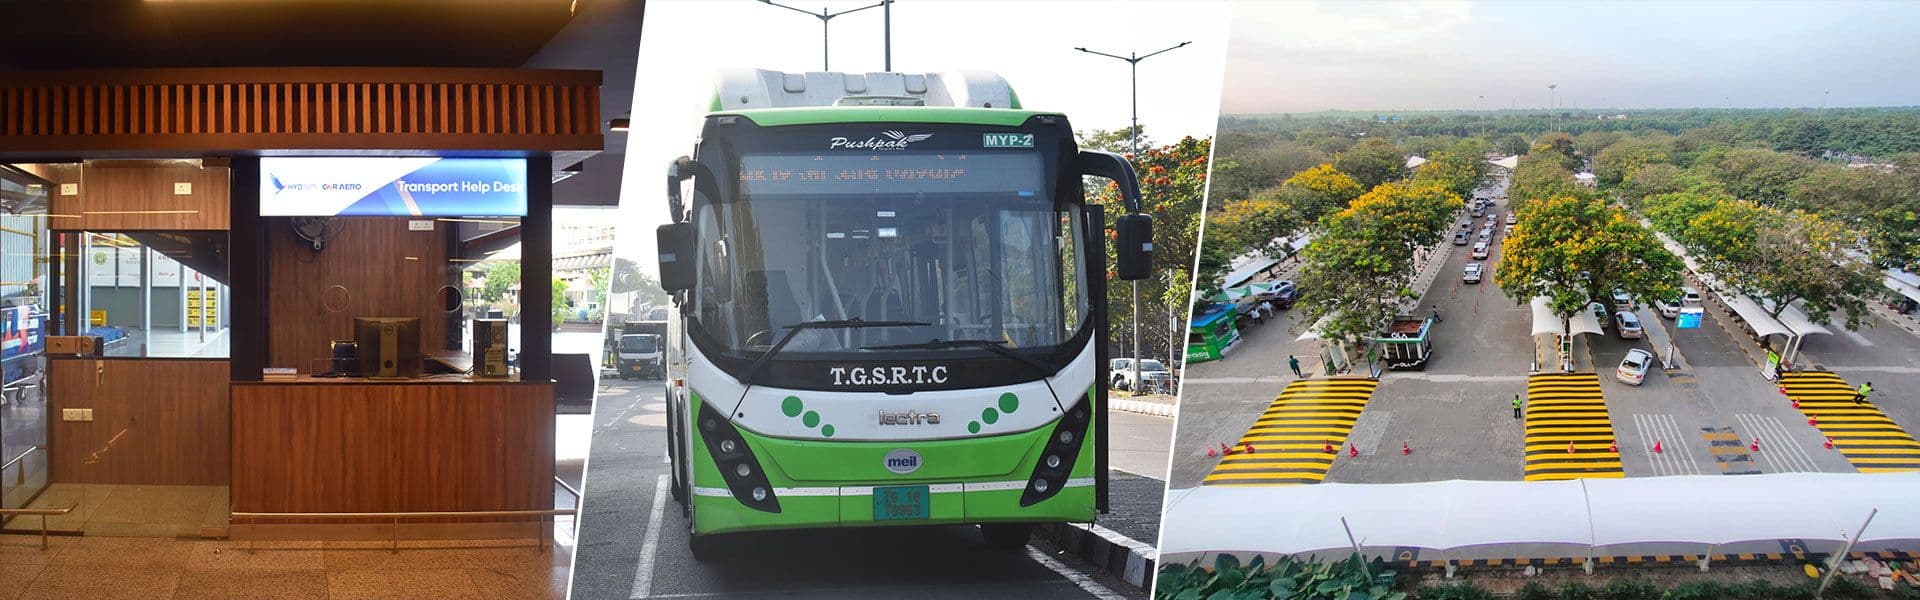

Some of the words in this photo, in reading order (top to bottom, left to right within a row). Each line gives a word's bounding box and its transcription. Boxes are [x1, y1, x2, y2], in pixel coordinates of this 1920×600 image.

[830, 136, 908, 150] Pushpak
[985, 135, 1032, 146] MYP-2
[398, 181, 458, 194] Transport
[461, 181, 490, 194] Help
[830, 366, 948, 385] T.G.S.R.T.C
[888, 456, 917, 467] meil
